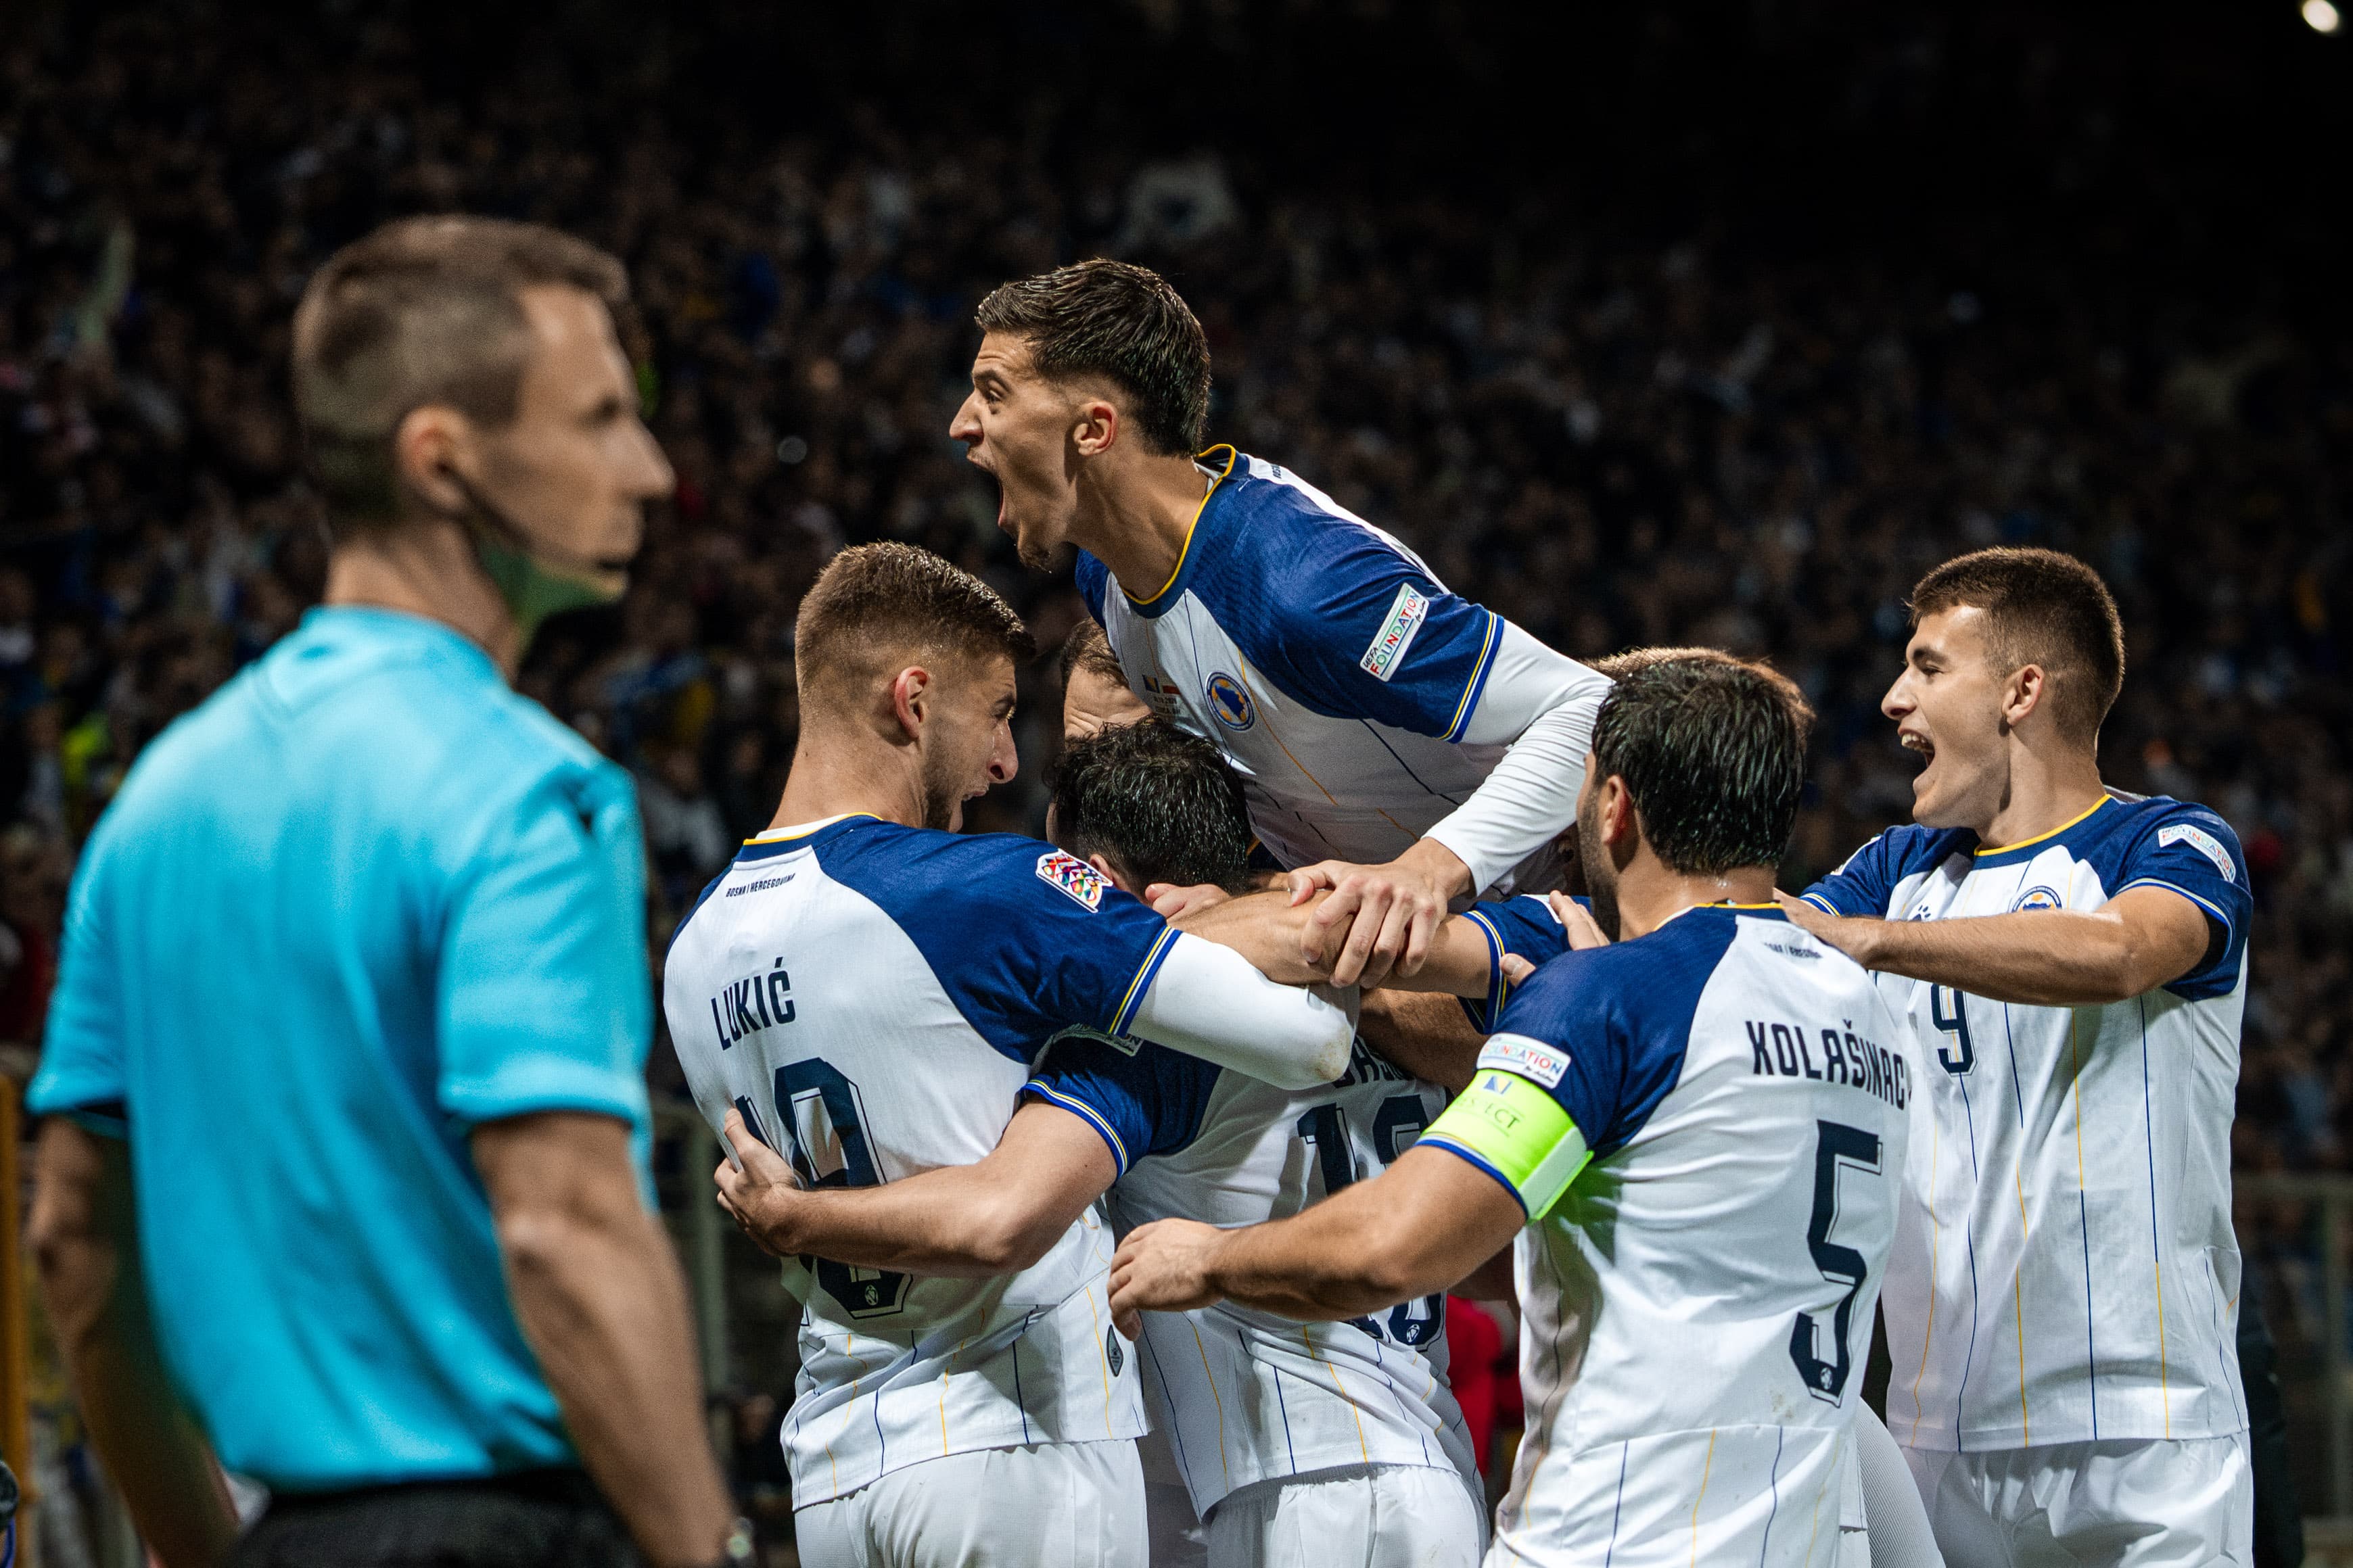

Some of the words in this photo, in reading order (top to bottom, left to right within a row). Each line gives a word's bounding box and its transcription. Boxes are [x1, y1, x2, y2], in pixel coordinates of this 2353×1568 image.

[1363, 647, 1378, 668] UEFA
[1370, 590, 1420, 675] FOUNDATION
[726, 885, 747, 898] BOSNA
[711, 957, 796, 1051] LUKIĆ
[1930, 982, 1978, 1077] 9
[1789, 1119, 1884, 1408] 5
